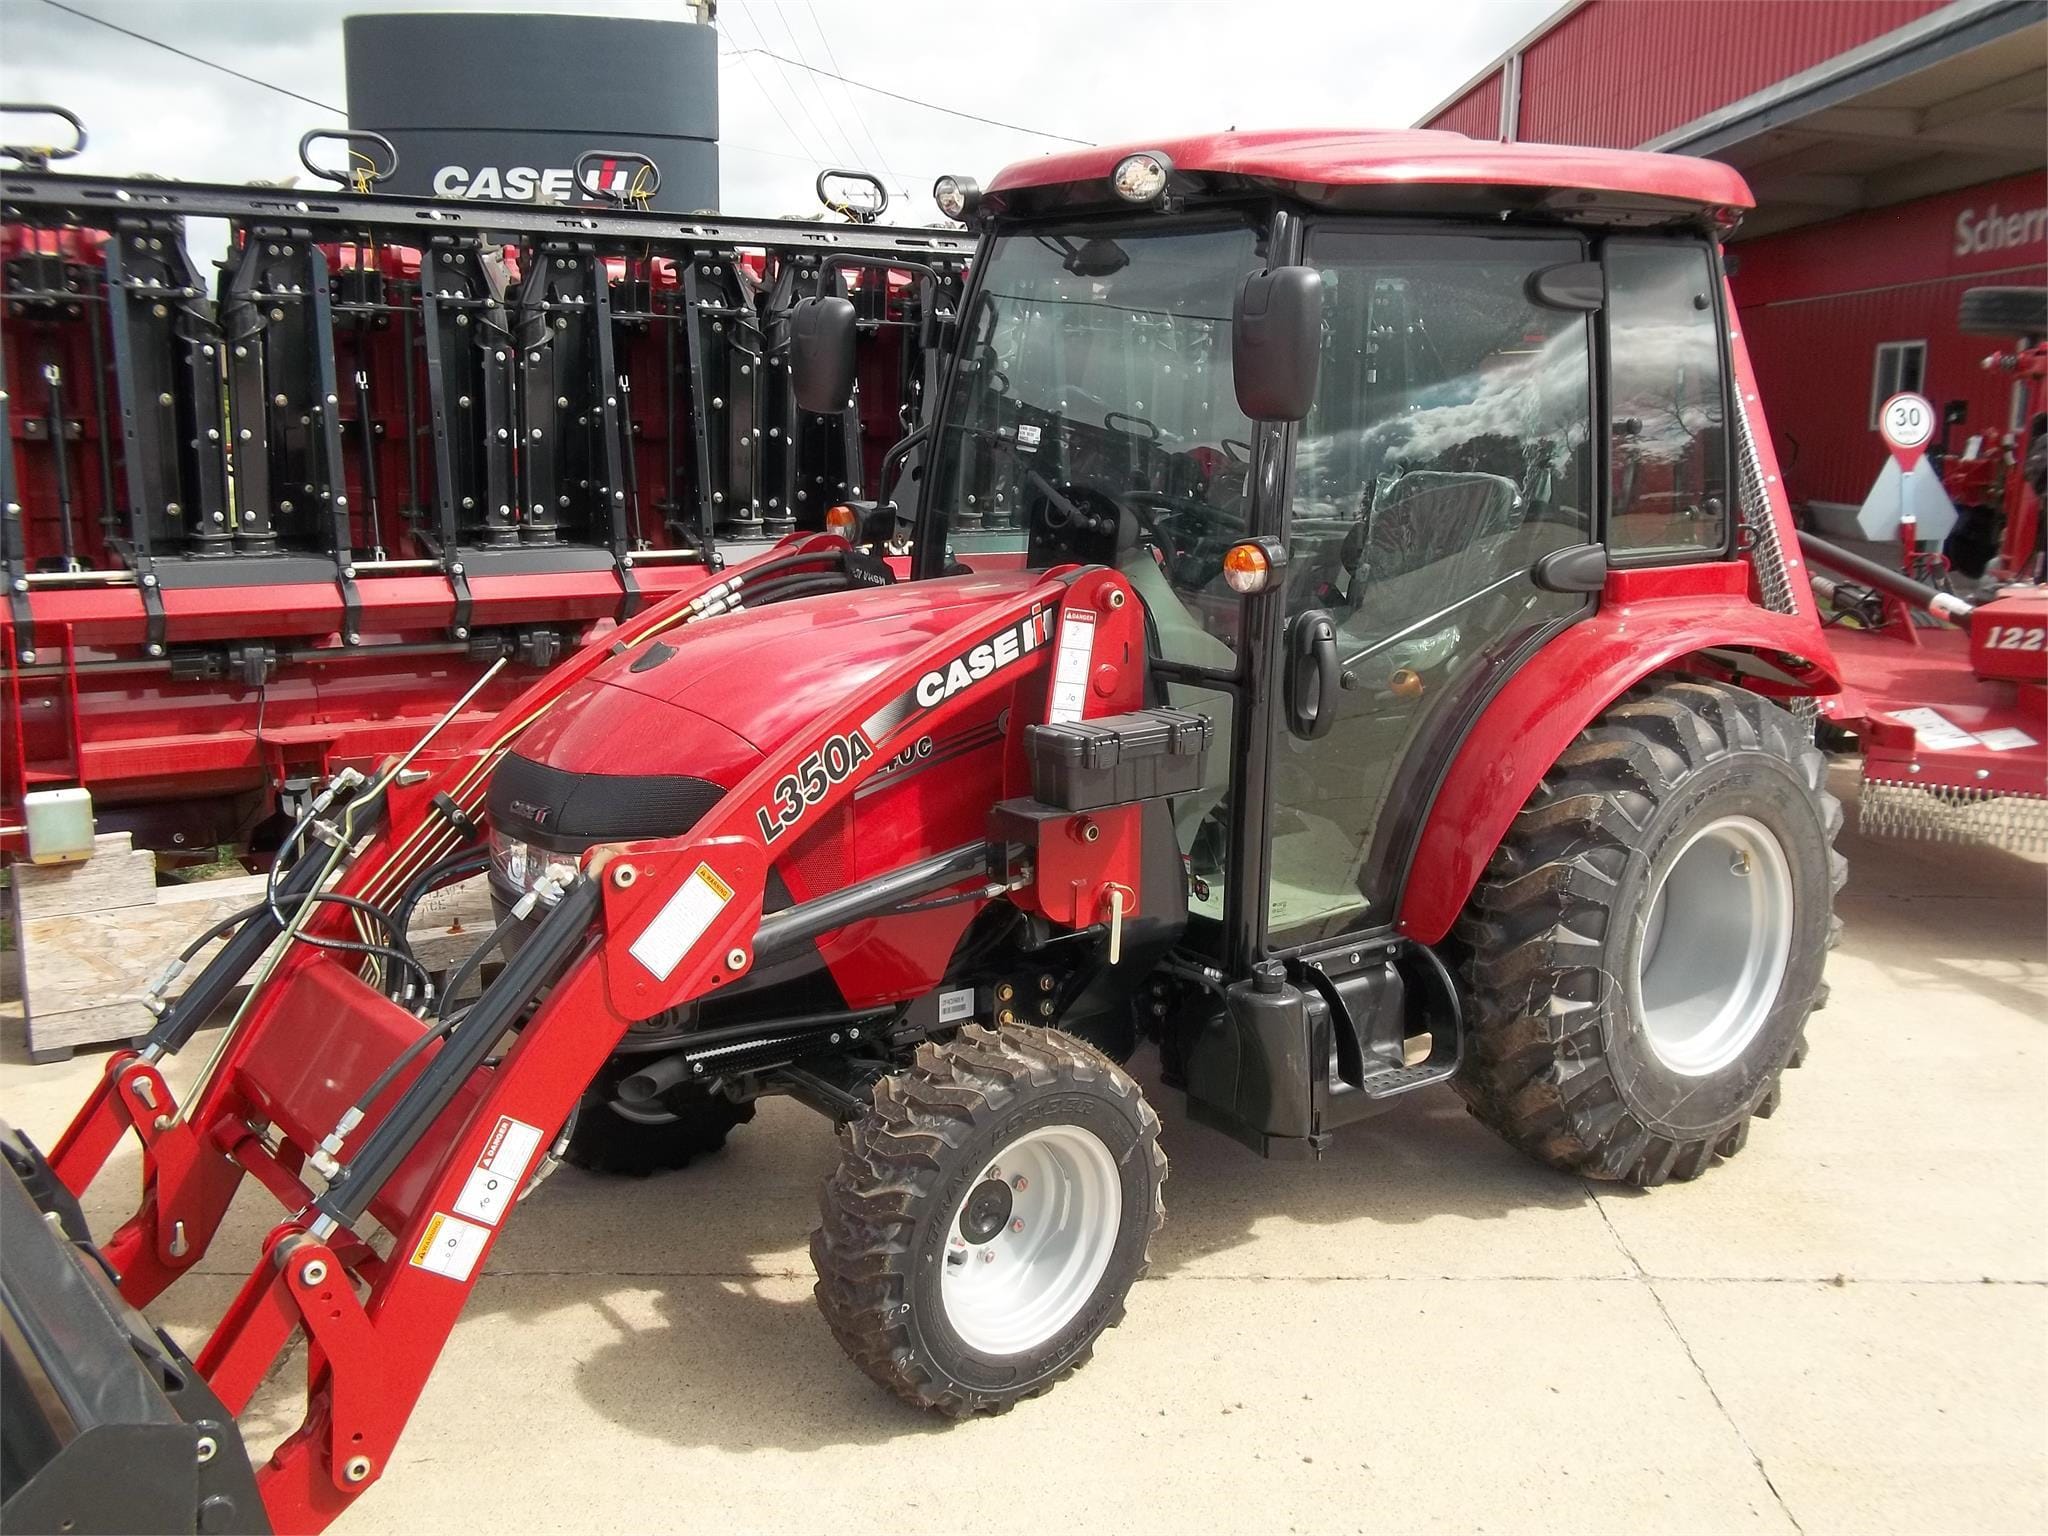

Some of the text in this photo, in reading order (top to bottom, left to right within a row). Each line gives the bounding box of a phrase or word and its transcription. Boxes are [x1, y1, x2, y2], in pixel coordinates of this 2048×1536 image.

[433, 166, 573, 200] CASE
[1895, 407, 1920, 427] 30
[1072, 612, 1094, 621] DANGER
[1984, 626, 2048, 652] 122
[916, 627, 1020, 708] CASE
[756, 730, 874, 846] L350A
[487, 1121, 510, 1158] DANGER
[422, 1219, 443, 1252] WARNING
